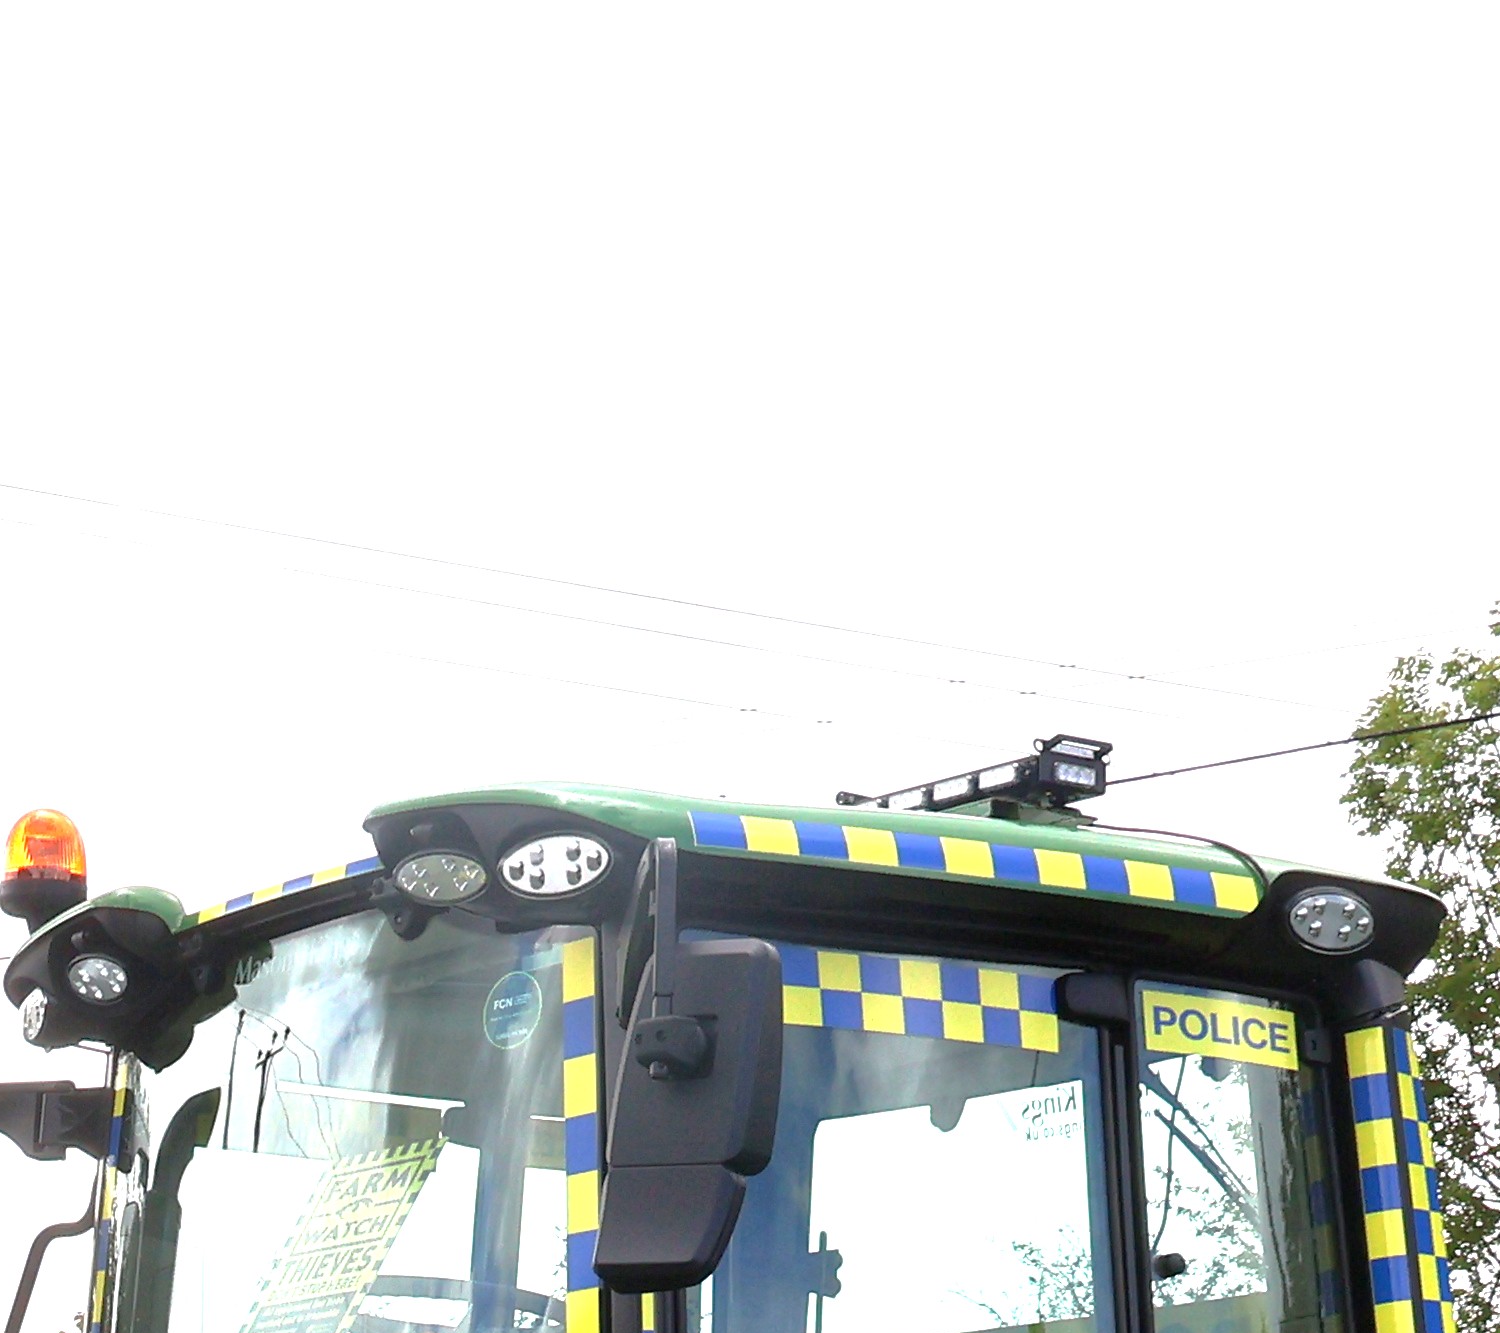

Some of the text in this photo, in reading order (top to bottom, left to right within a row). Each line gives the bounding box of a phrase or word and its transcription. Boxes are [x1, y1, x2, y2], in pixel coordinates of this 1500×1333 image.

[493, 997, 513, 1011] FCN
[1152, 1005, 1291, 1054] POLICE
[324, 1165, 413, 1203] FARM
[304, 1213, 390, 1246] WATCH
[278, 1244, 379, 1286] THIEVES
